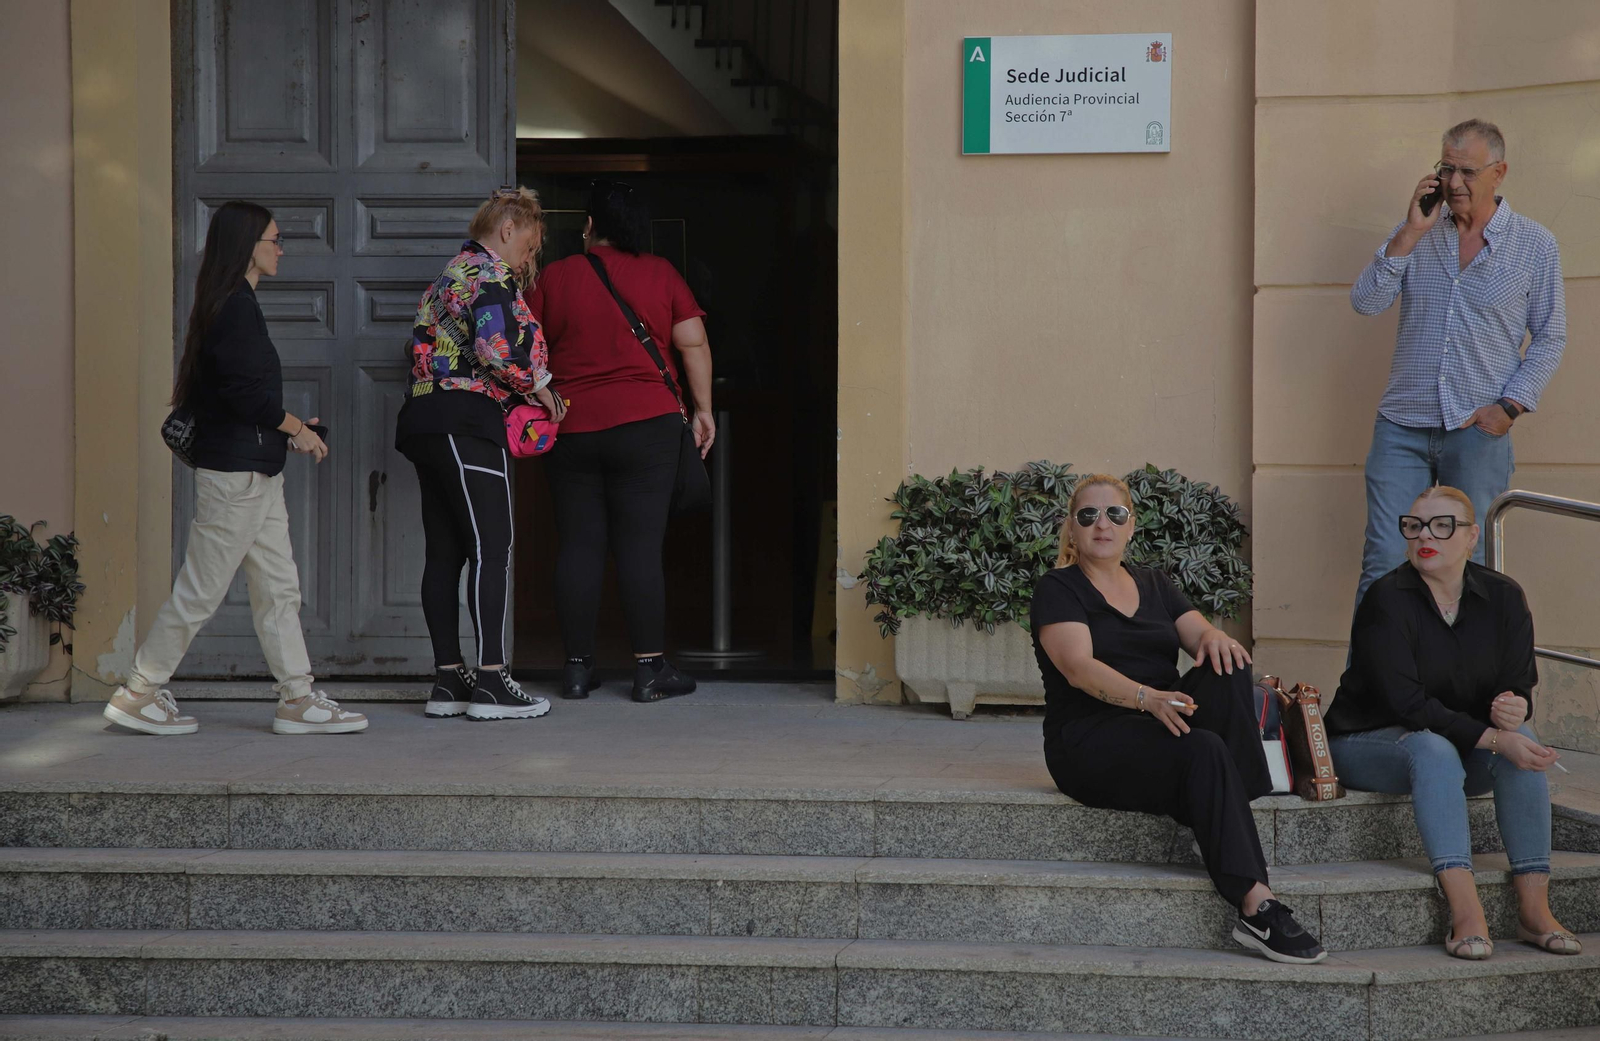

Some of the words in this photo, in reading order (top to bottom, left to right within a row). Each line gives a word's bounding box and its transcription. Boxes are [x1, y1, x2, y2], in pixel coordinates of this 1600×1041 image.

[1006, 67, 1050, 84] Sede
[1054, 66, 1126, 83] Judicial
[1004, 93, 1070, 106] Audiencia
[1073, 92, 1140, 105] Provincial
[1005, 109, 1056, 123] Sección
[1311, 723, 1327, 758] KORS
